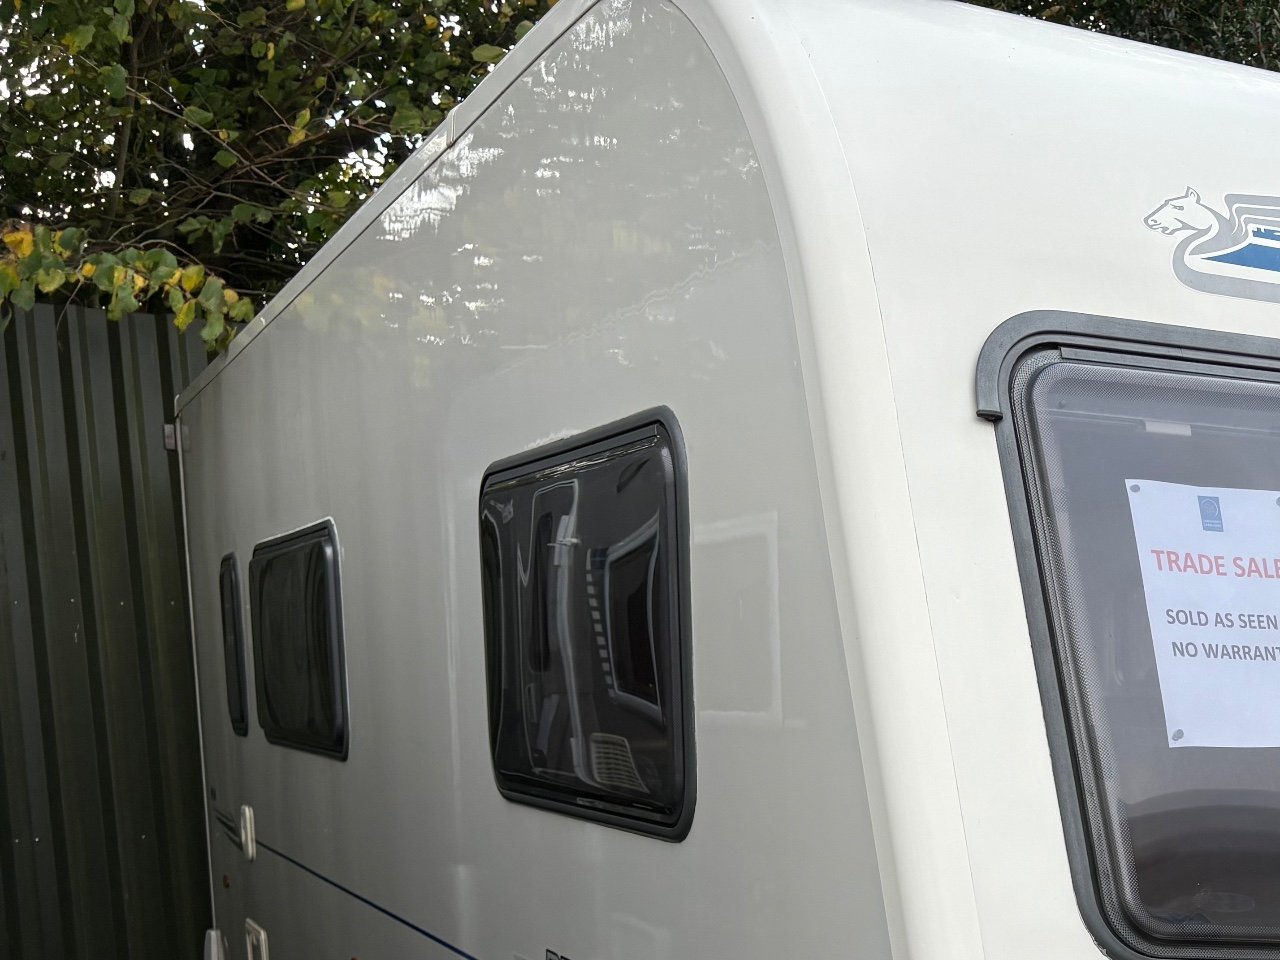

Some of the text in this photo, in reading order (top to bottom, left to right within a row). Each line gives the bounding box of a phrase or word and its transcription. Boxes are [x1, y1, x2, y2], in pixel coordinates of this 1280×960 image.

[1151, 549, 1228, 577] TRADE
[1165, 608, 1279, 631] SOLD AS SEEN
[1171, 641, 1198, 658] NO
